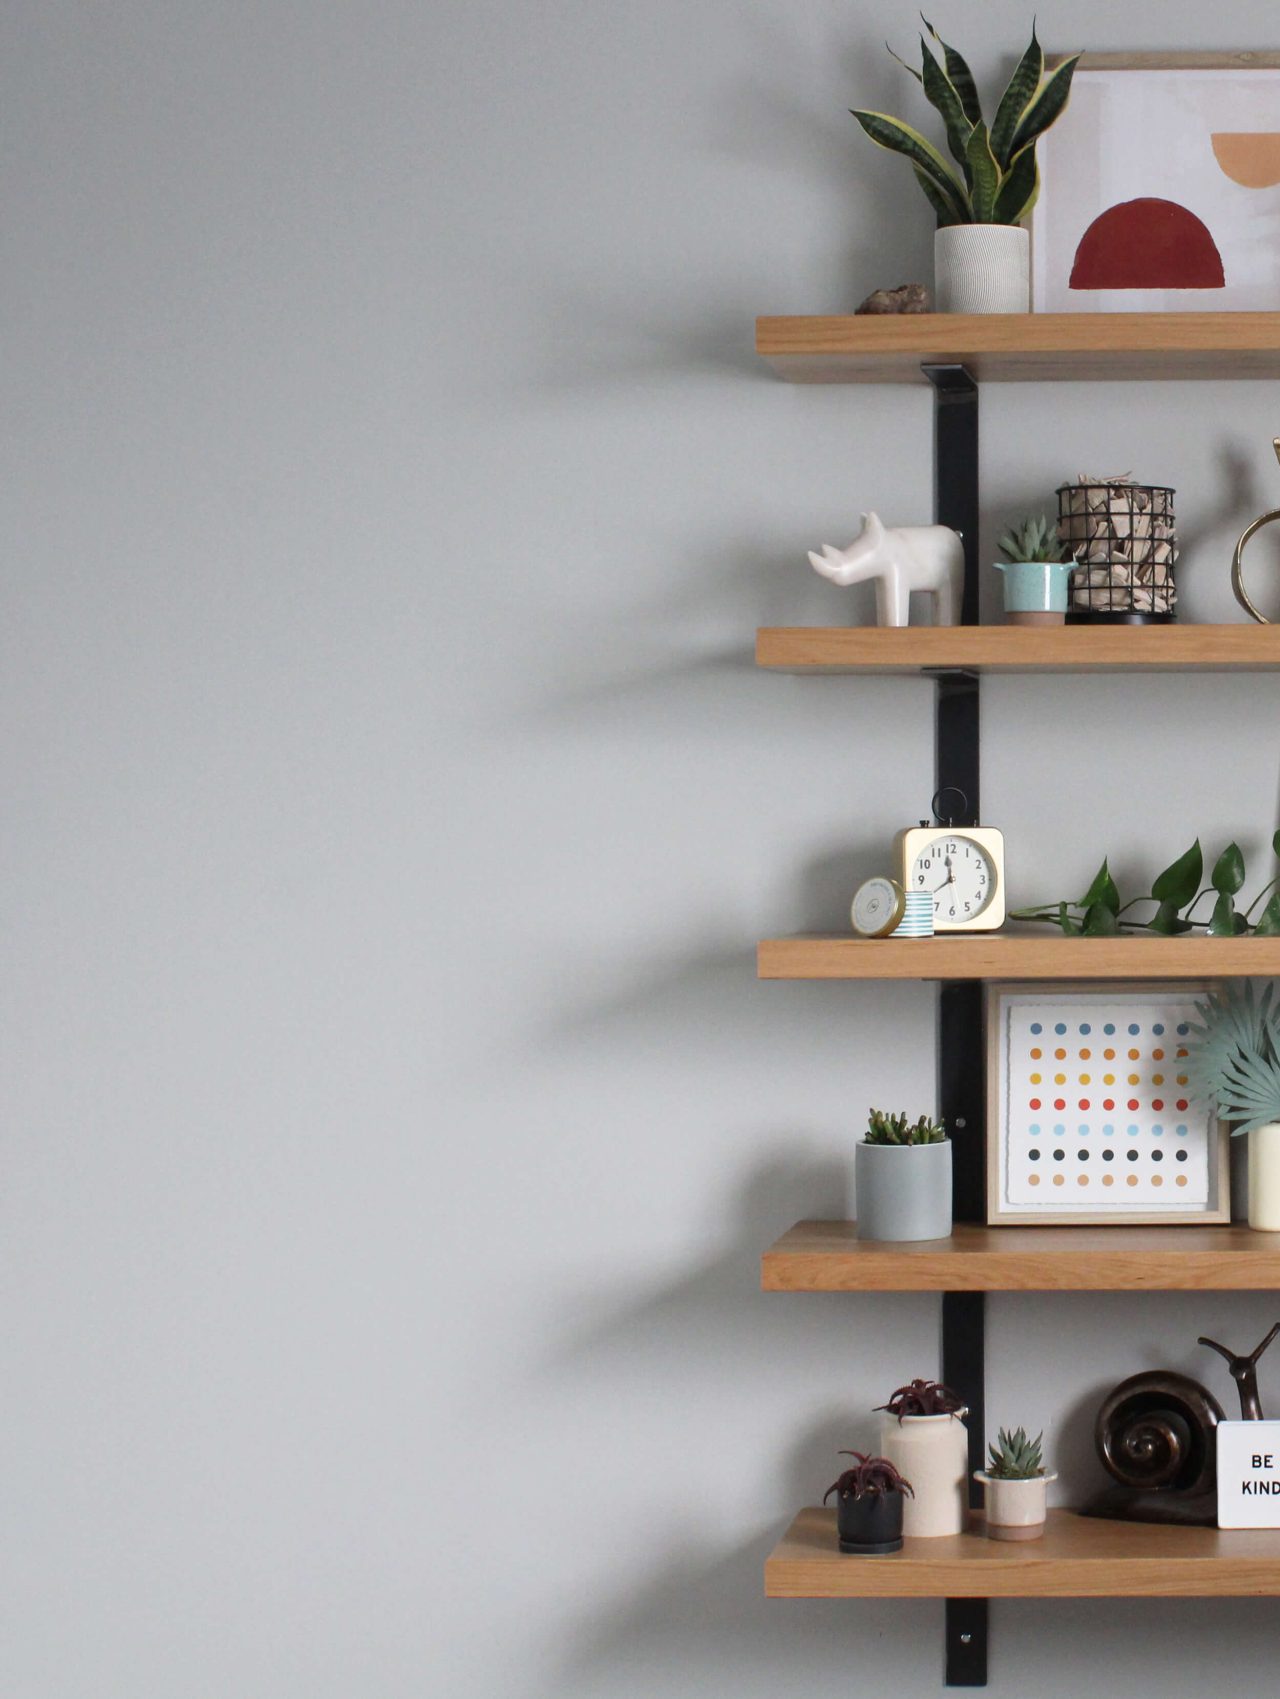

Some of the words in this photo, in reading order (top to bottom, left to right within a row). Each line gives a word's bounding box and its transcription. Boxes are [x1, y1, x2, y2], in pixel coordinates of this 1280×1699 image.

[931, 847, 941, 859] 11
[945, 843, 957, 854] 12
[919, 858, 931, 870] 10
[975, 859, 982, 870] 2
[917, 874, 925, 886] 9
[979, 874, 986, 885] 3
[974, 890, 982, 901] 4
[933, 901, 941, 912] 7
[948, 905, 956, 917] 6
[964, 901, 971, 912] 5
[1251, 1454, 1274, 1469] BE
